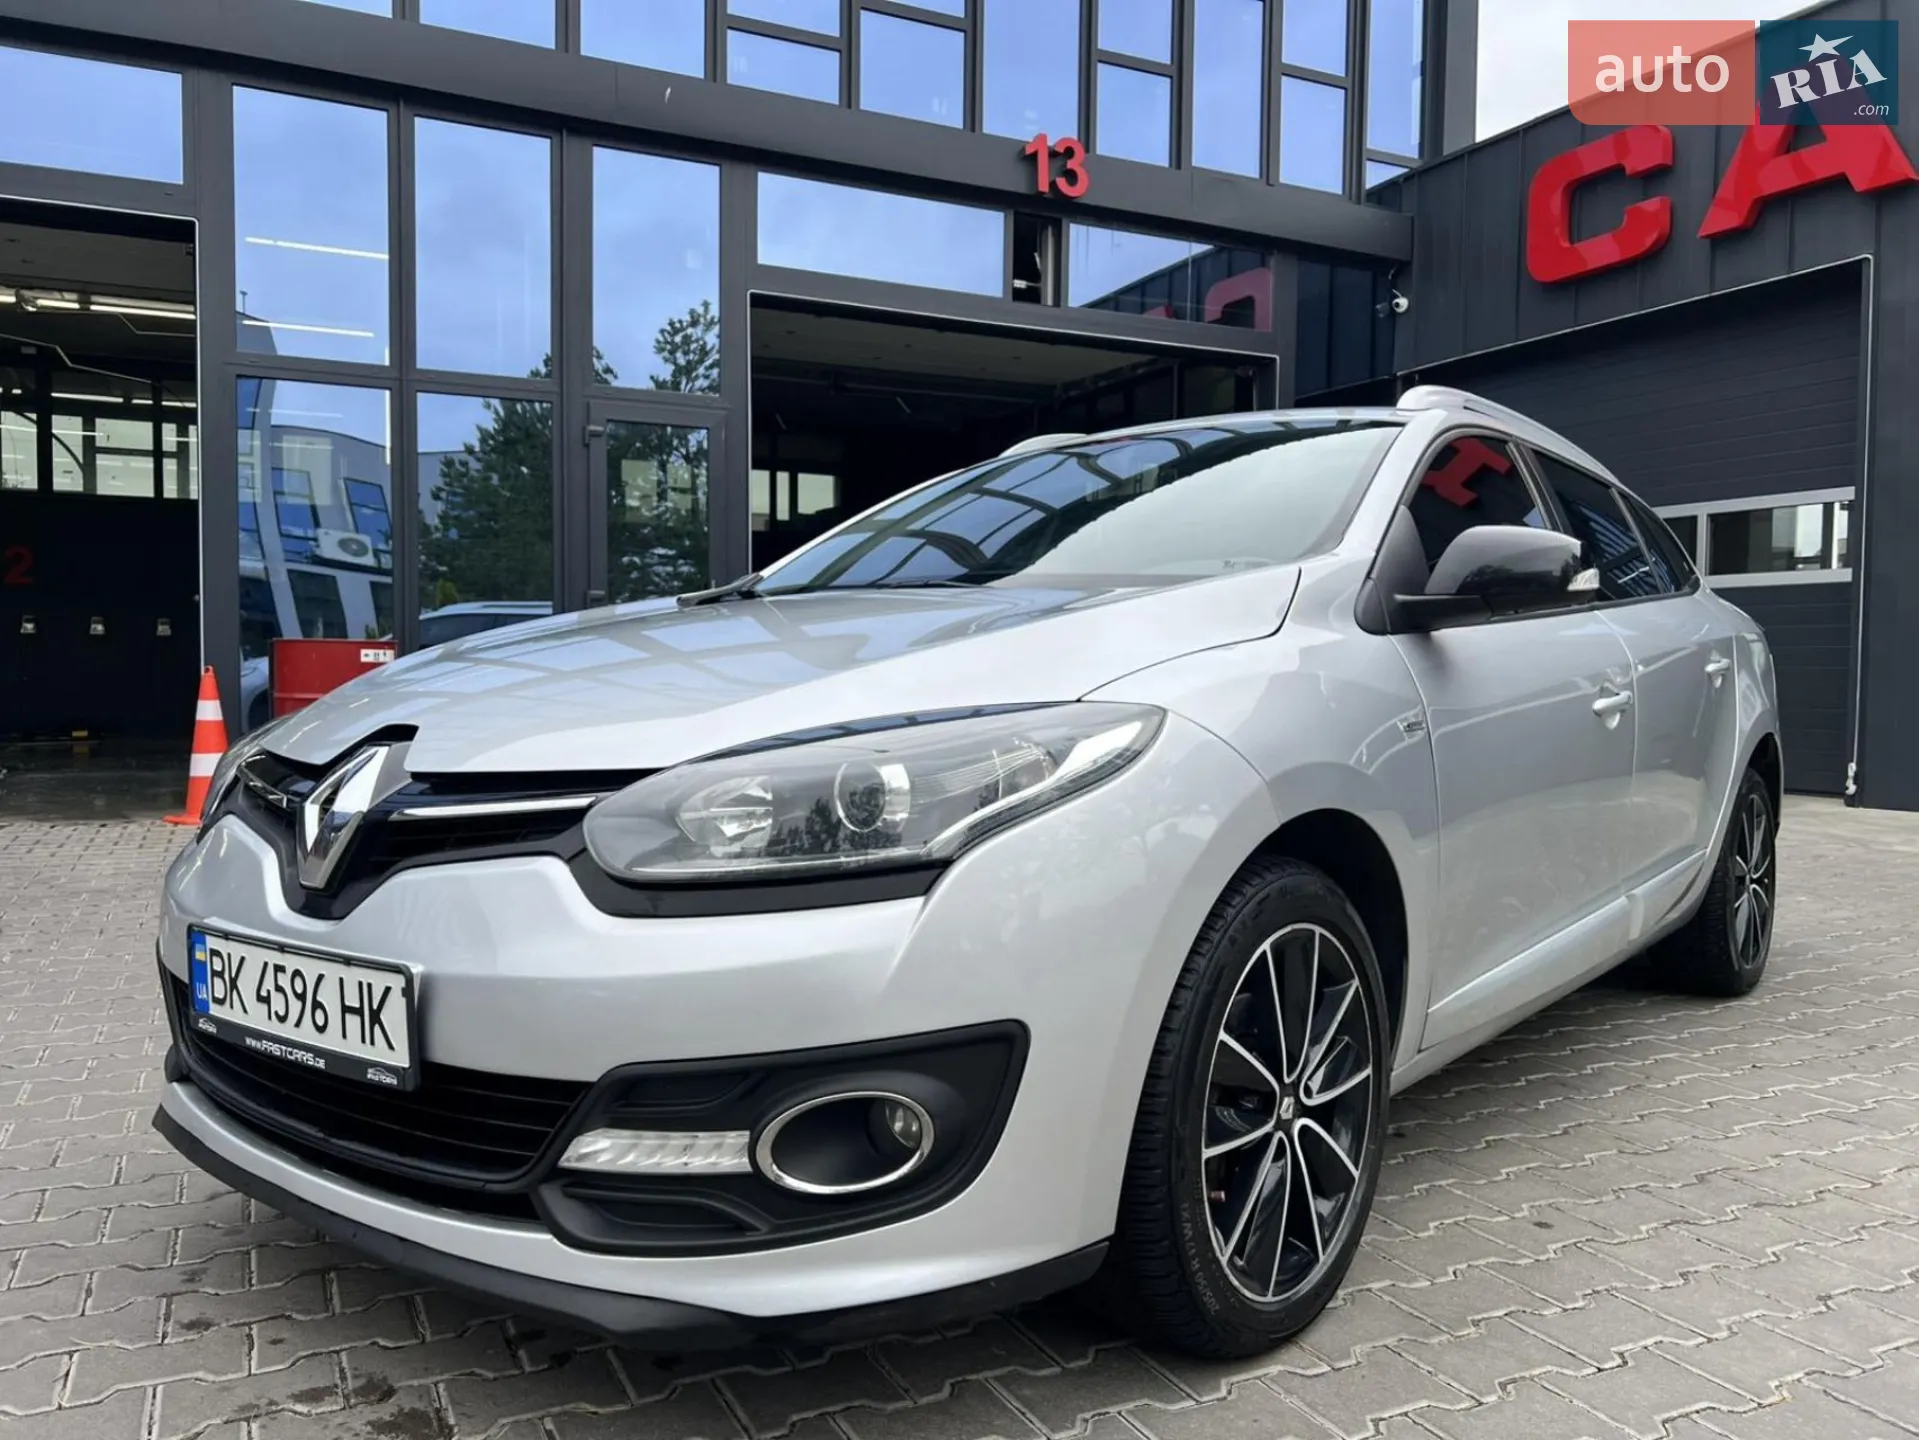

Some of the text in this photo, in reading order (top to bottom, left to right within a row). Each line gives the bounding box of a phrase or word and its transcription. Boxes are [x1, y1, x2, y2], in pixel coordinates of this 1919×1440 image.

[1025, 133, 1089, 198] 13
[3, 546, 34, 584] 2
[196, 981, 208, 1000] UA
[210, 948, 396, 1051] BK 4596 HK
